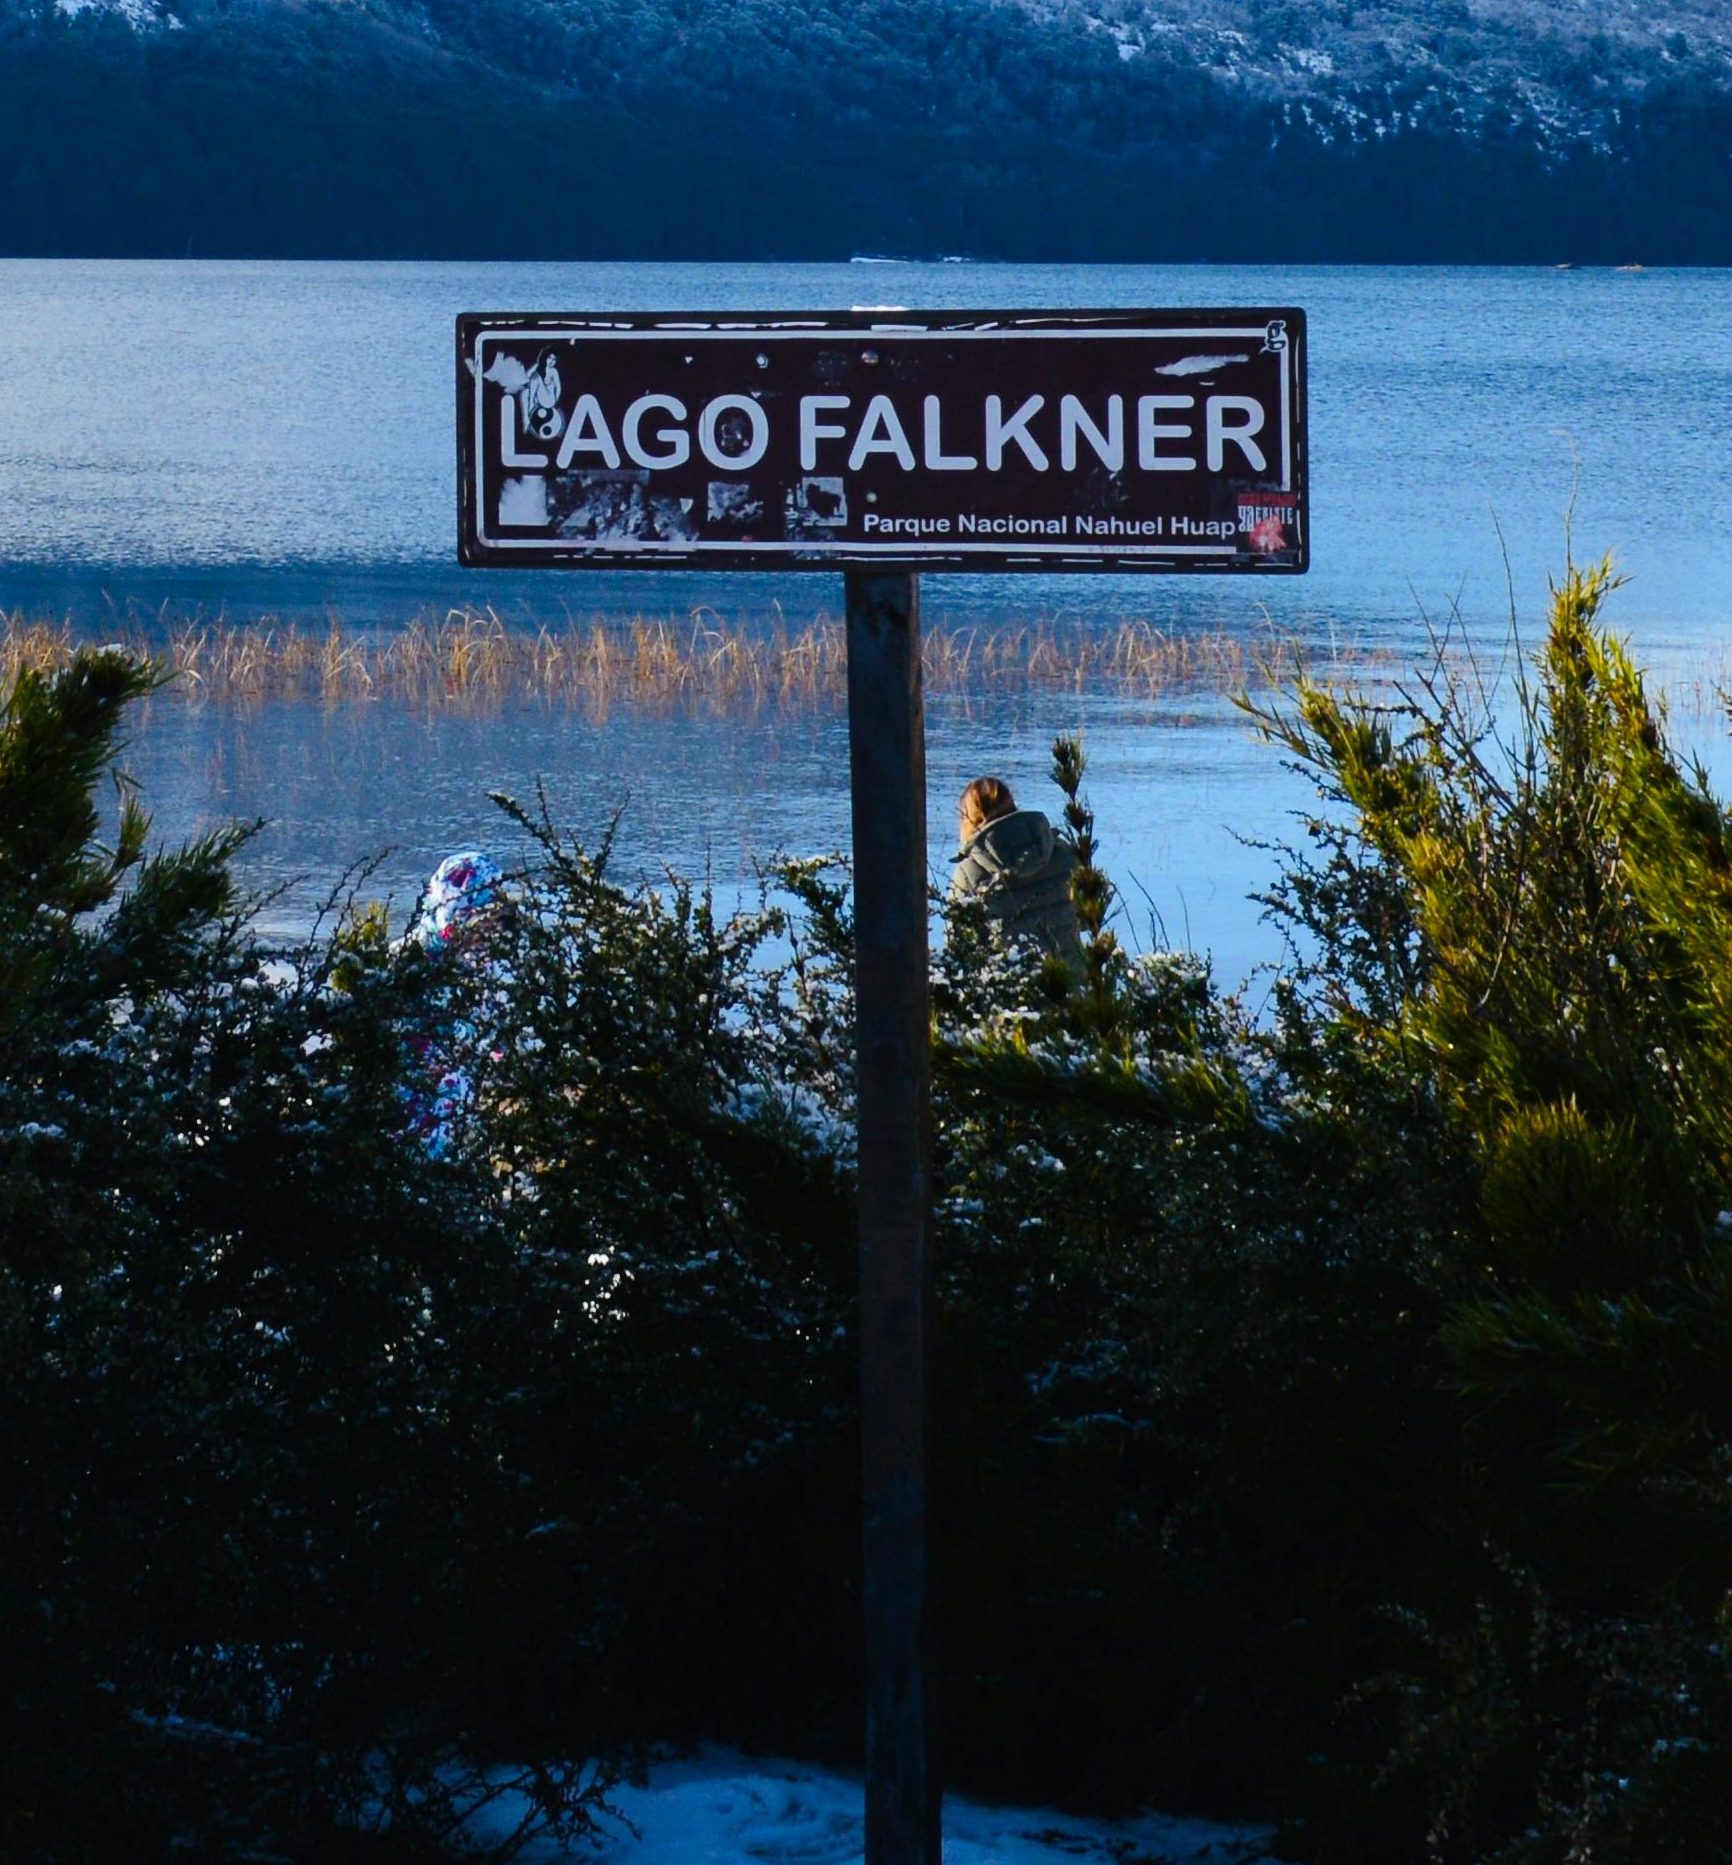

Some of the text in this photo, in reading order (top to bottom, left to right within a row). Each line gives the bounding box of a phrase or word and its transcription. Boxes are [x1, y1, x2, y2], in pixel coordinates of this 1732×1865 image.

[501, 394, 1267, 472] LAGO FALKNER
[864, 514, 1236, 540] Parque Nacional Nahuel Huap
